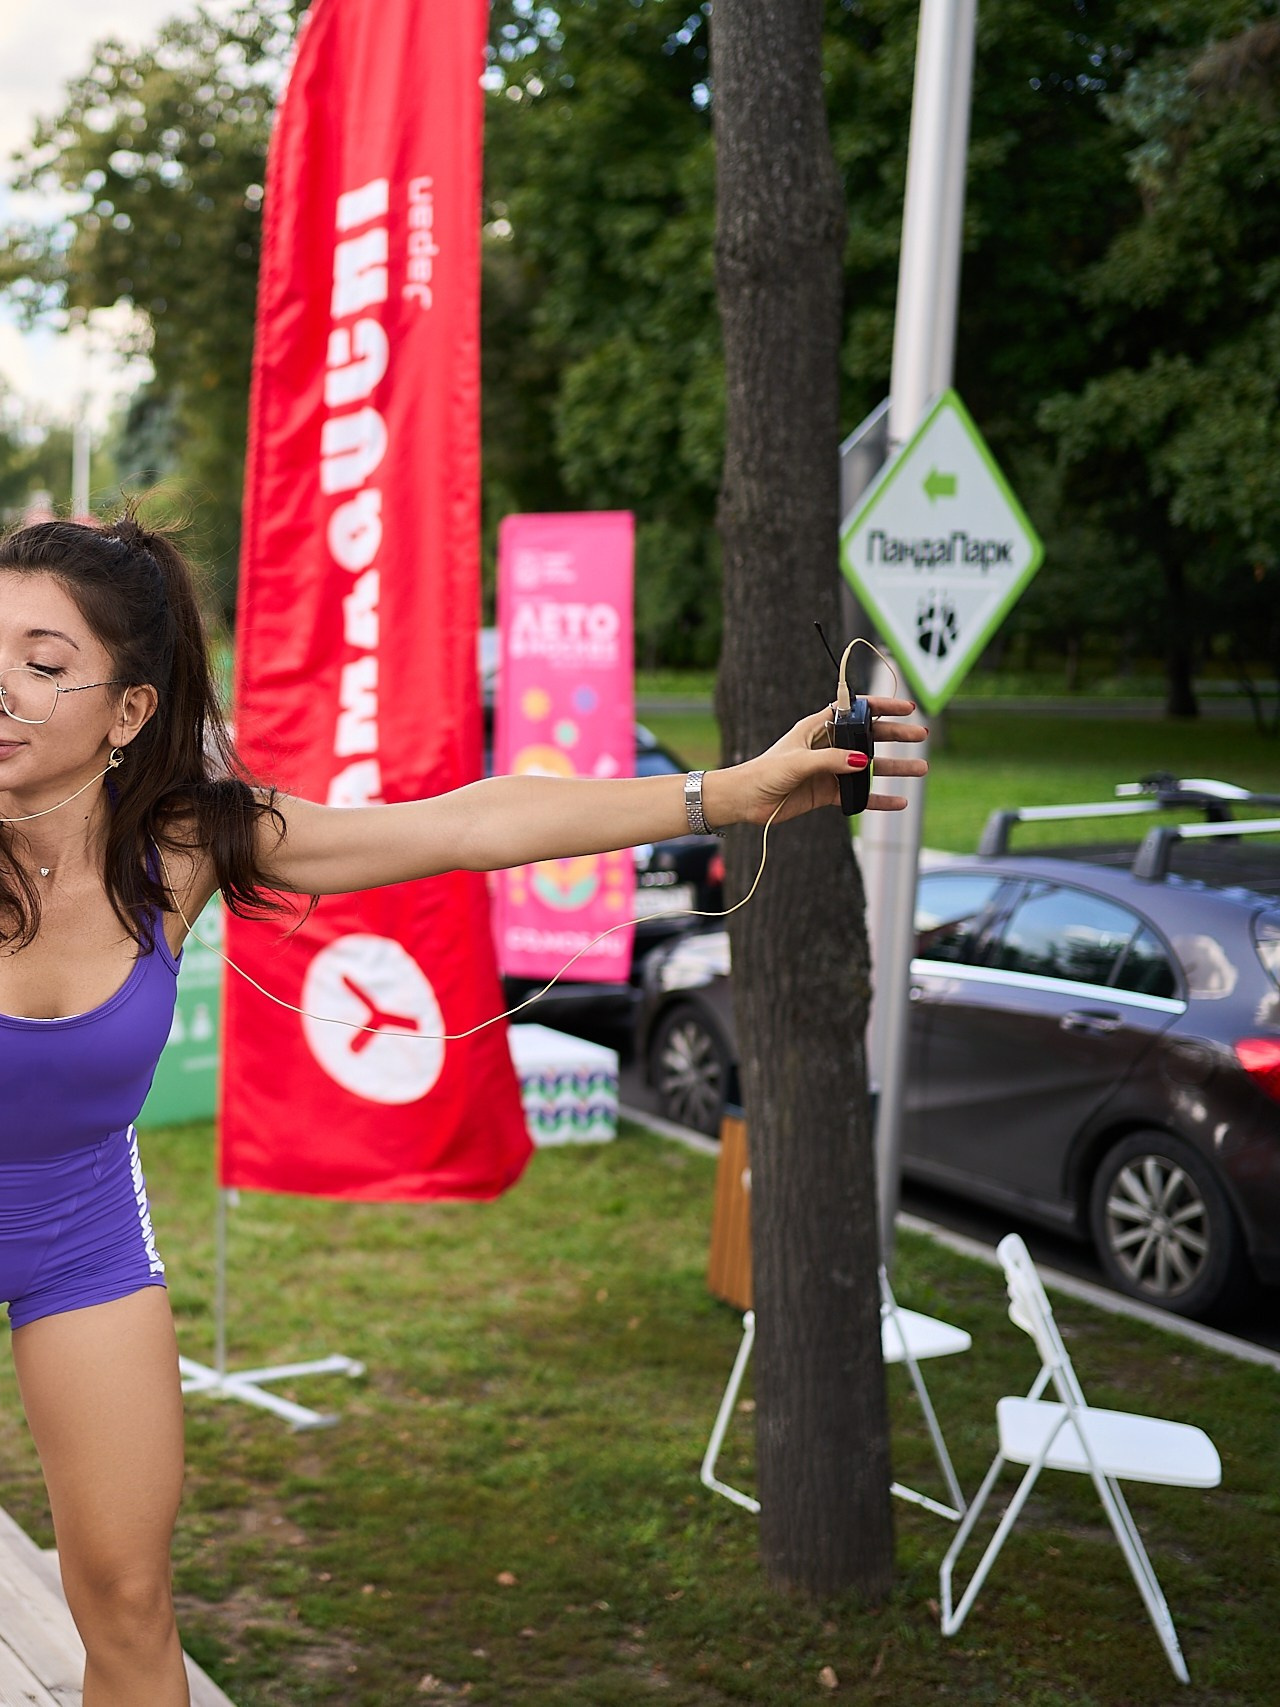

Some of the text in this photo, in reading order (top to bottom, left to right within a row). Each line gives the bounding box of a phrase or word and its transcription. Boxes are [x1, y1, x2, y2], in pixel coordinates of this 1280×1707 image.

[401, 175, 440, 311] Japan
[320, 177, 390, 809] AMAGUCHI
[866, 529, 1013, 571] ПандаПарк
